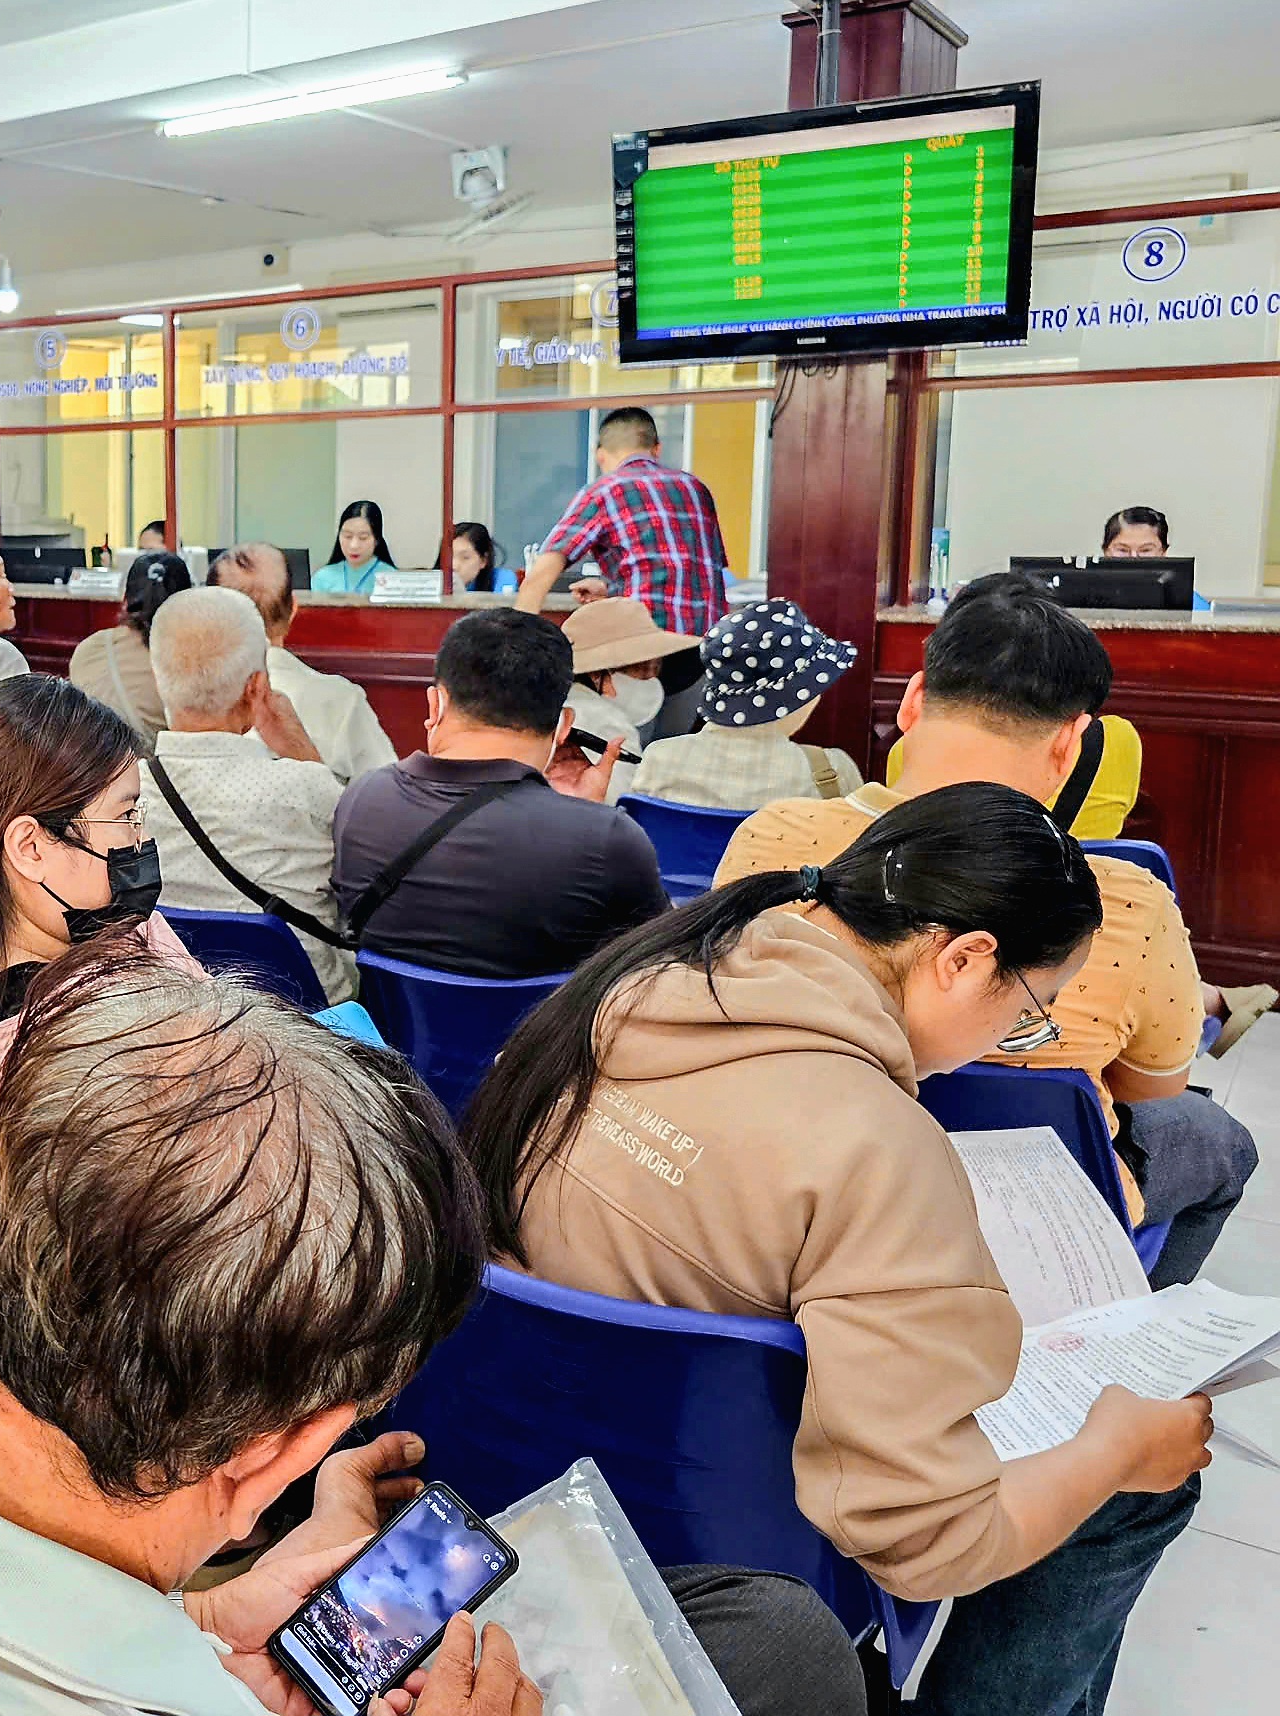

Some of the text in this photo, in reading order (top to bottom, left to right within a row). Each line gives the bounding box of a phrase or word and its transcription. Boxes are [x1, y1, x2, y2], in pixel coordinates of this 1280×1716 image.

[1144, 240, 1164, 267] 8
[927, 308, 962, 320] TRANG
[1030, 305, 1070, 332] TRỢ
[1076, 302, 1100, 326] XÃ
[1109, 298, 1148, 329] HỘI,
[1158, 293, 1221, 321] NGƯỜI
[1231, 288, 1259, 316] CÓ
[294, 318, 305, 337] 6
[46, 339, 56, 358] 5
[636, 1145, 685, 1186] WORLD
